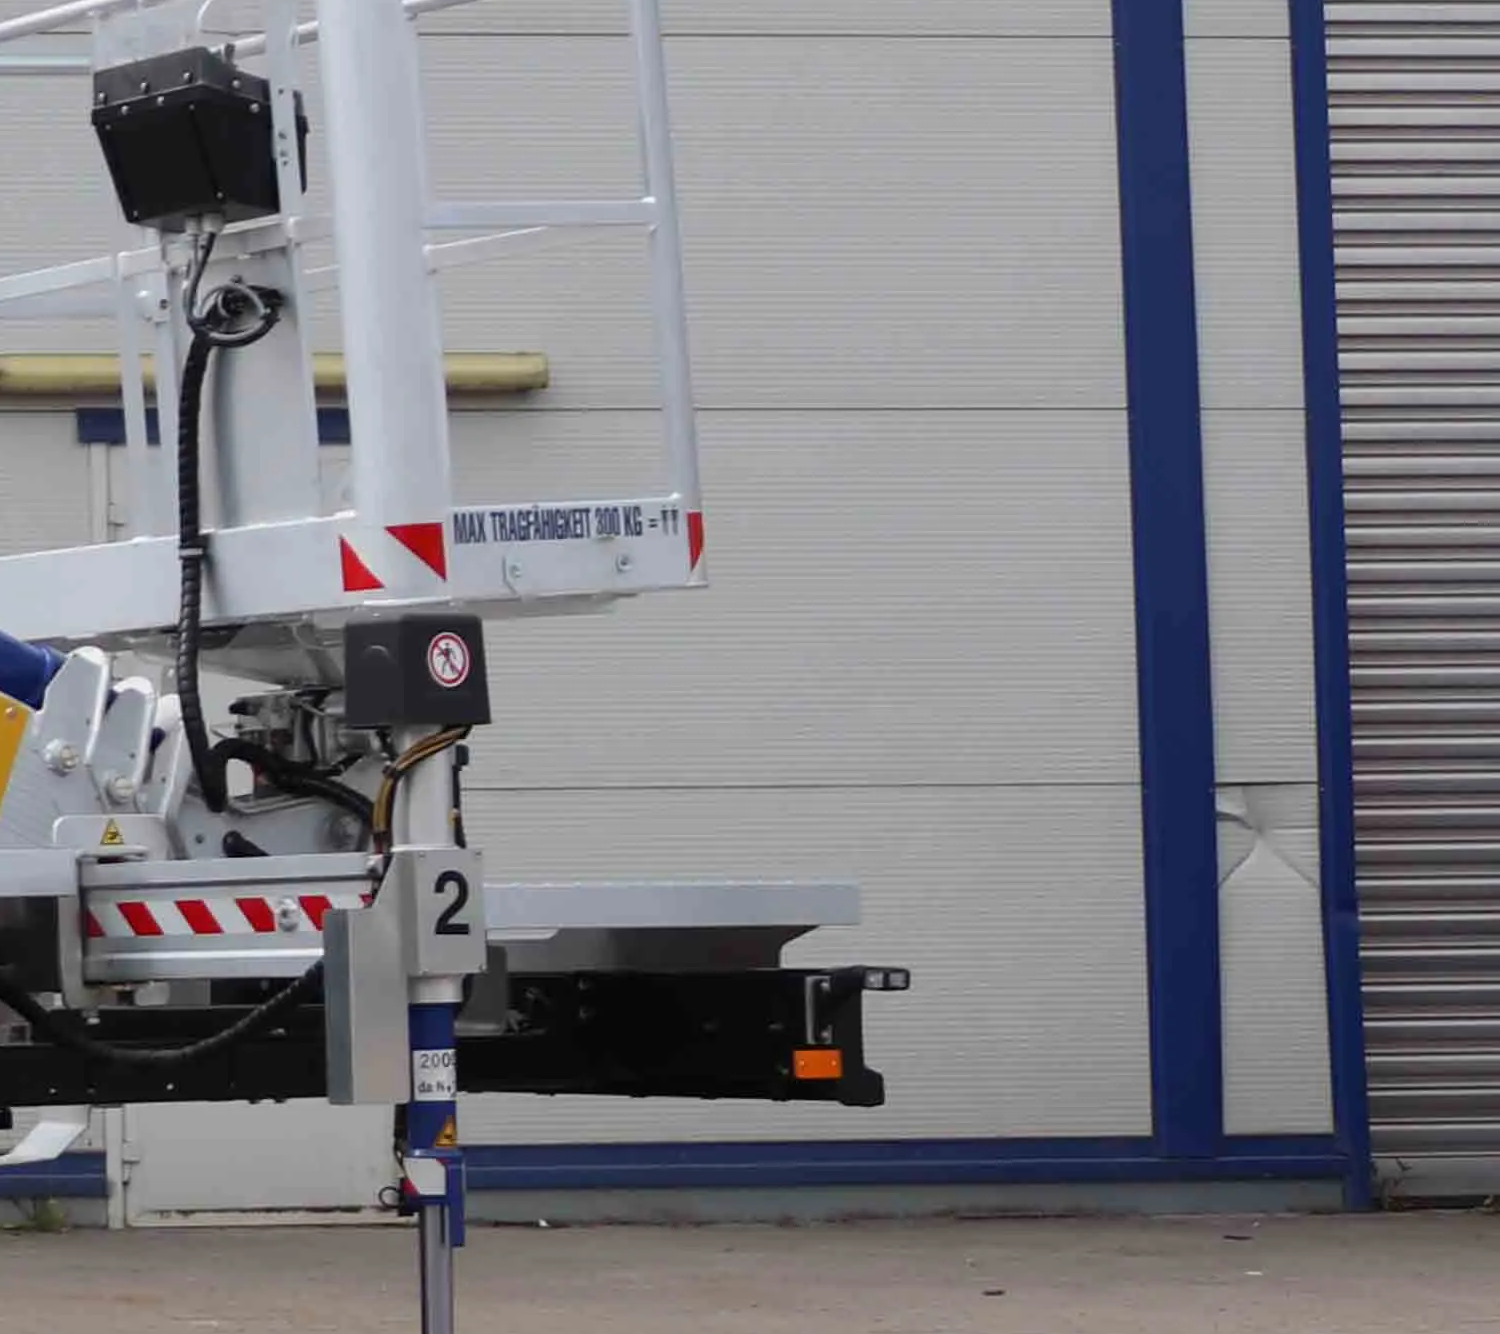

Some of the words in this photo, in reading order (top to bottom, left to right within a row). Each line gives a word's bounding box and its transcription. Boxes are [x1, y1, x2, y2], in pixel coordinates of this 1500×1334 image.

[452, 512, 487, 545] MAX
[489, 504, 592, 543] TRAGFÄHIGKEIT
[595, 508, 621, 536] 300
[623, 505, 643, 536] KG
[433, 870, 471, 936] 2
